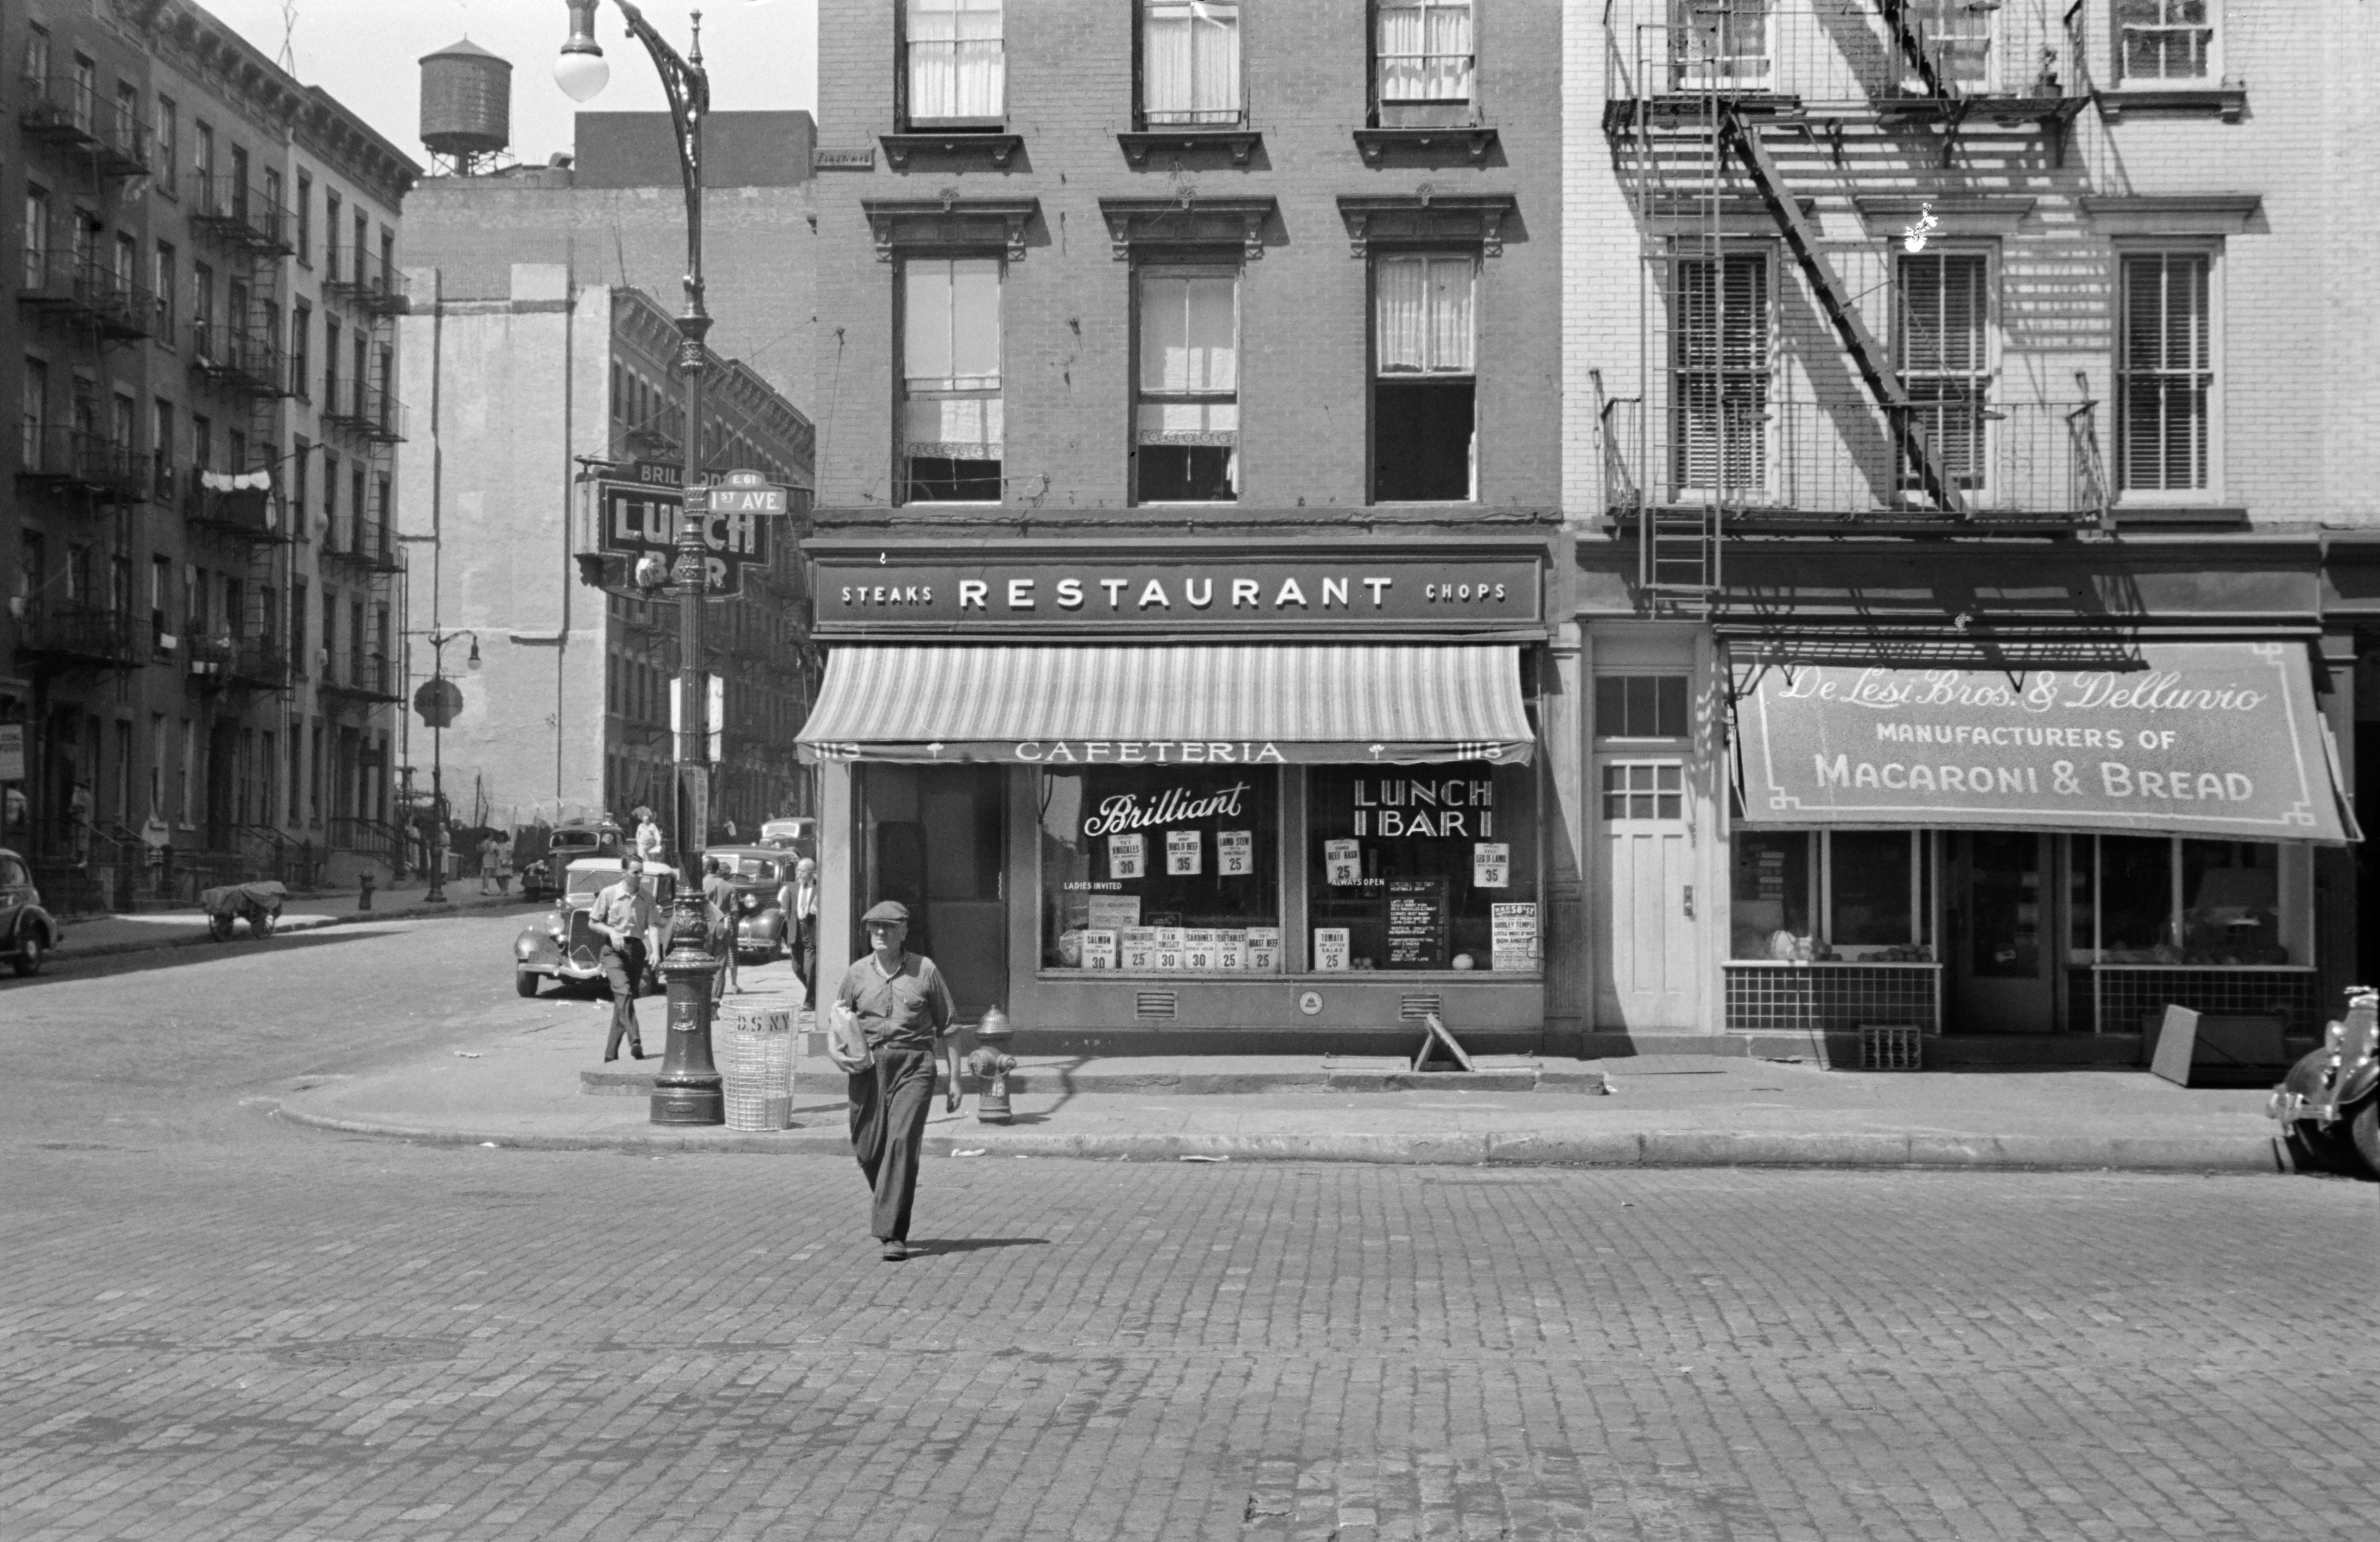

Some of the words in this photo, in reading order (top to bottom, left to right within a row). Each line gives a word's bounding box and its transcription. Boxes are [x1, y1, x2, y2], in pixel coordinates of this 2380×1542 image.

[743, 474, 756, 484] 61
[742, 492, 780, 510] AVE.
[842, 586, 932, 601] STEAKS
[960, 578, 1391, 607] RESTAURANT
[1425, 583, 1504, 598] CHOPS
[1779, 660, 1837, 699] De
[1839, 664, 1915, 709] Lesi
[1915, 666, 2017, 706] Bros.
[2021, 670, 2058, 713] &
[2064, 670, 2268, 710] Delluvio
[1876, 723, 2123, 749] MANUFACTURERS
[2139, 730, 2176, 749] OF
[814, 742, 861, 759] 1113
[1015, 742, 1287, 763] CAFETERIA
[1457, 742, 1502, 760] 1113
[1815, 753, 2039, 794] MACARONI
[2052, 760, 2084, 796] &
[2101, 762, 2253, 801] BREAD
[1354, 779, 1492, 807] LUNCH
[1084, 781, 1251, 836] Brilliant
[1378, 809, 1468, 837] BAR
[1219, 837, 1234, 847] LAMB
[1236, 837, 1250, 846] STEW
[1120, 860, 1134, 874] 30
[1177, 857, 1191, 871] 35
[1229, 858, 1242, 871] 25
[1337, 865, 1350, 879] 25
[1485, 869, 1498, 882] 35
[1087, 935, 1111, 944] SALMON
[1187, 934, 1213, 942] SARDINES
[1266, 939, 1279, 947] BEEF
[1321, 933, 1343, 942] TOMATO
[1092, 956, 1105, 969] 30
[1132, 953, 1145, 966] 25
[1161, 954, 1175, 967] 30
[1193, 954, 1206, 967] 30
[1223, 954, 1236, 967] 25
[1257, 954, 1269, 967] 25
[1326, 954, 1338, 967] 25
